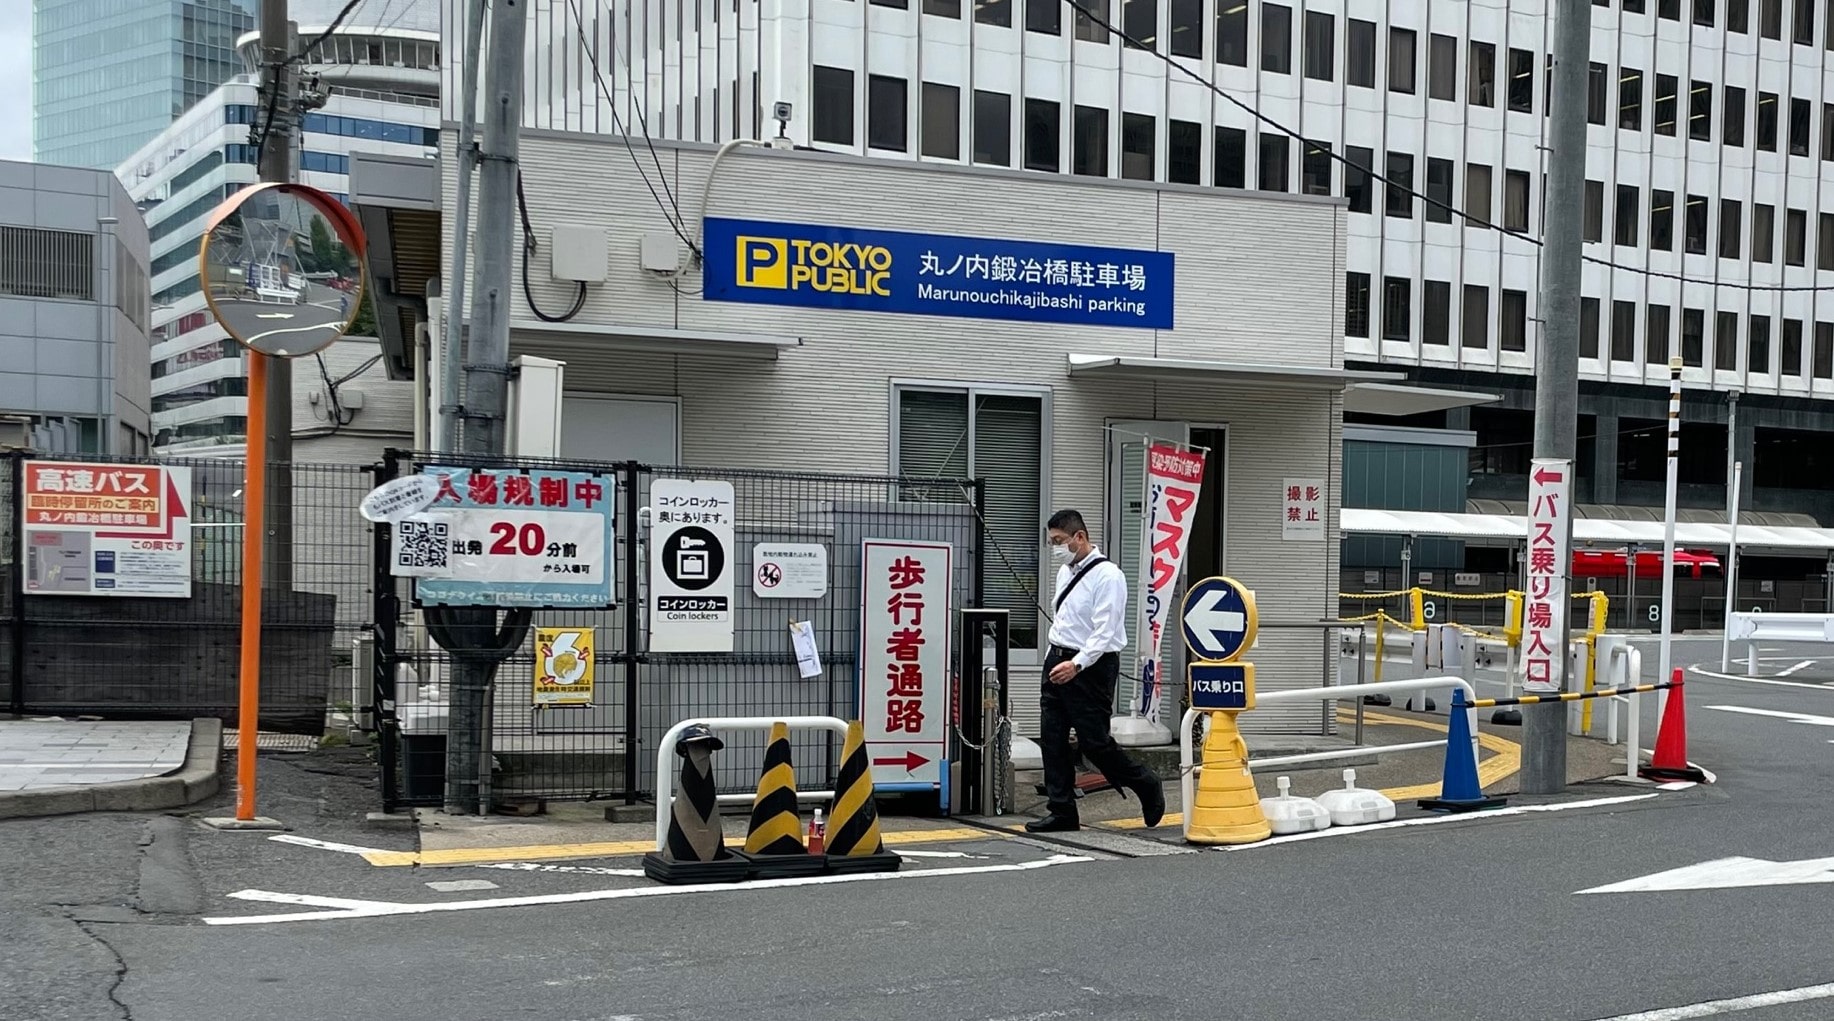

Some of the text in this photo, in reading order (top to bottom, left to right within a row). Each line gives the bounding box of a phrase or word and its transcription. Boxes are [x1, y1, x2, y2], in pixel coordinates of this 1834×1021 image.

[791, 239, 893, 271] TOKYO
[919, 250, 1146, 291] 丸ノ内鍛冶橋駐車場
[791, 264, 891, 296] PUBLIC
[918, 283, 1146, 316] Marunouchikajibashi parking
[36, 468, 150, 494] 高速バス
[432, 472, 602, 508] 入場規制中
[1287, 485, 1320, 501] 撮影
[659, 495, 730, 508] コインロッカー
[659, 511, 728, 525] 奥にあります。
[1287, 507, 1320, 521] 禁止
[131, 540, 185, 551] この奥です
[543, 564, 590, 574] から入場可
[1527, 493, 1559, 683] バス乗り場入口
[660, 599, 727, 610] コインロッカー
[1648, 604, 1660, 621] 8
[666, 611, 719, 620] Coin lockers
[885, 555, 926, 733] 歩行者通路
[1192, 679, 1244, 693] バス乗り口
